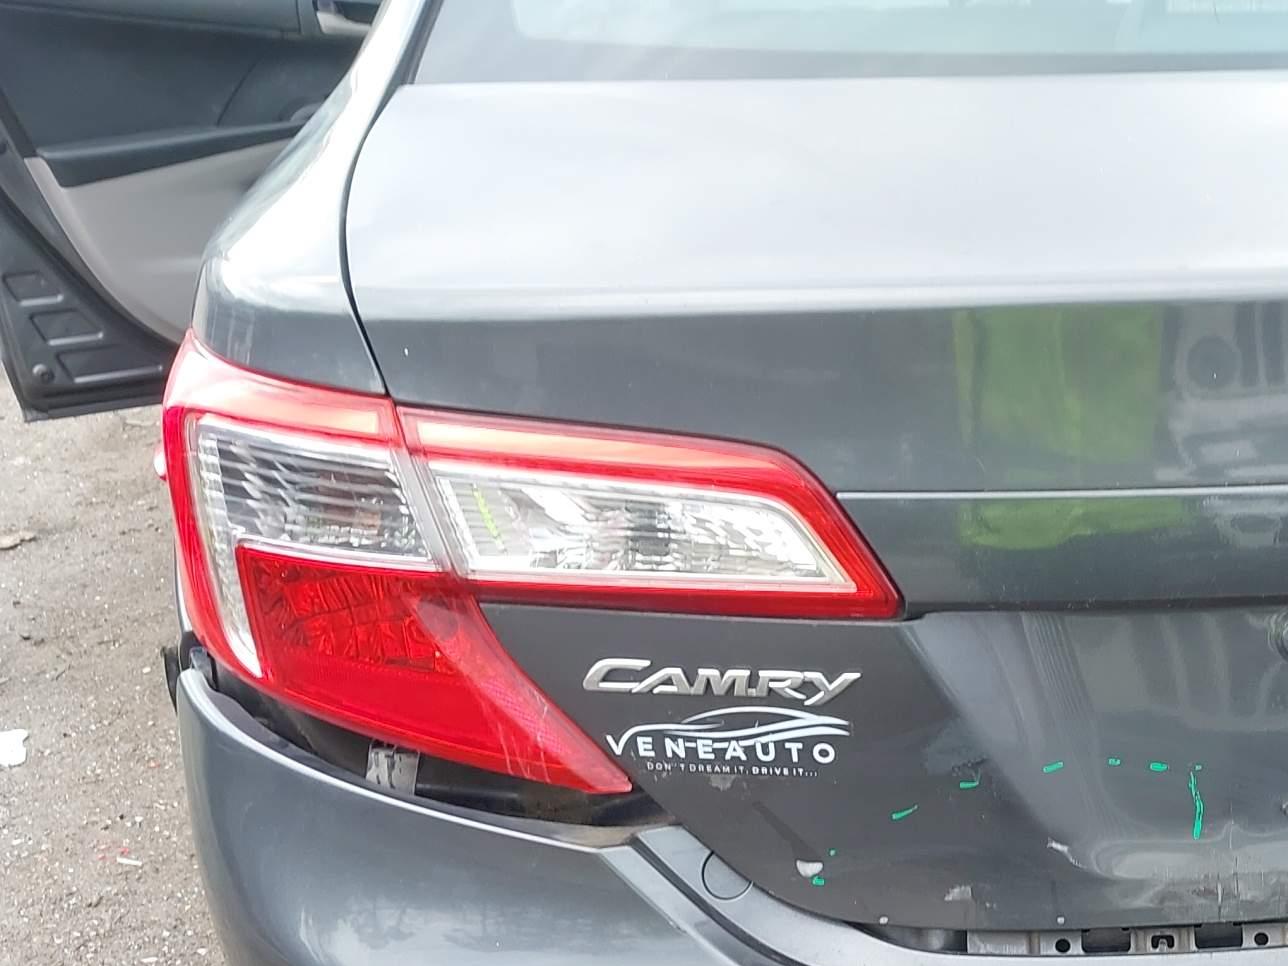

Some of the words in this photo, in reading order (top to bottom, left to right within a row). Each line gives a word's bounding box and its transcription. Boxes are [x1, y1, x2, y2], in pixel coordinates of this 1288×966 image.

[582, 658, 862, 706] CAMRY
[605, 734, 837, 765] VENEAUTO
[689, 763, 731, 774] DREAM
[751, 766, 789, 776] DRIVE
